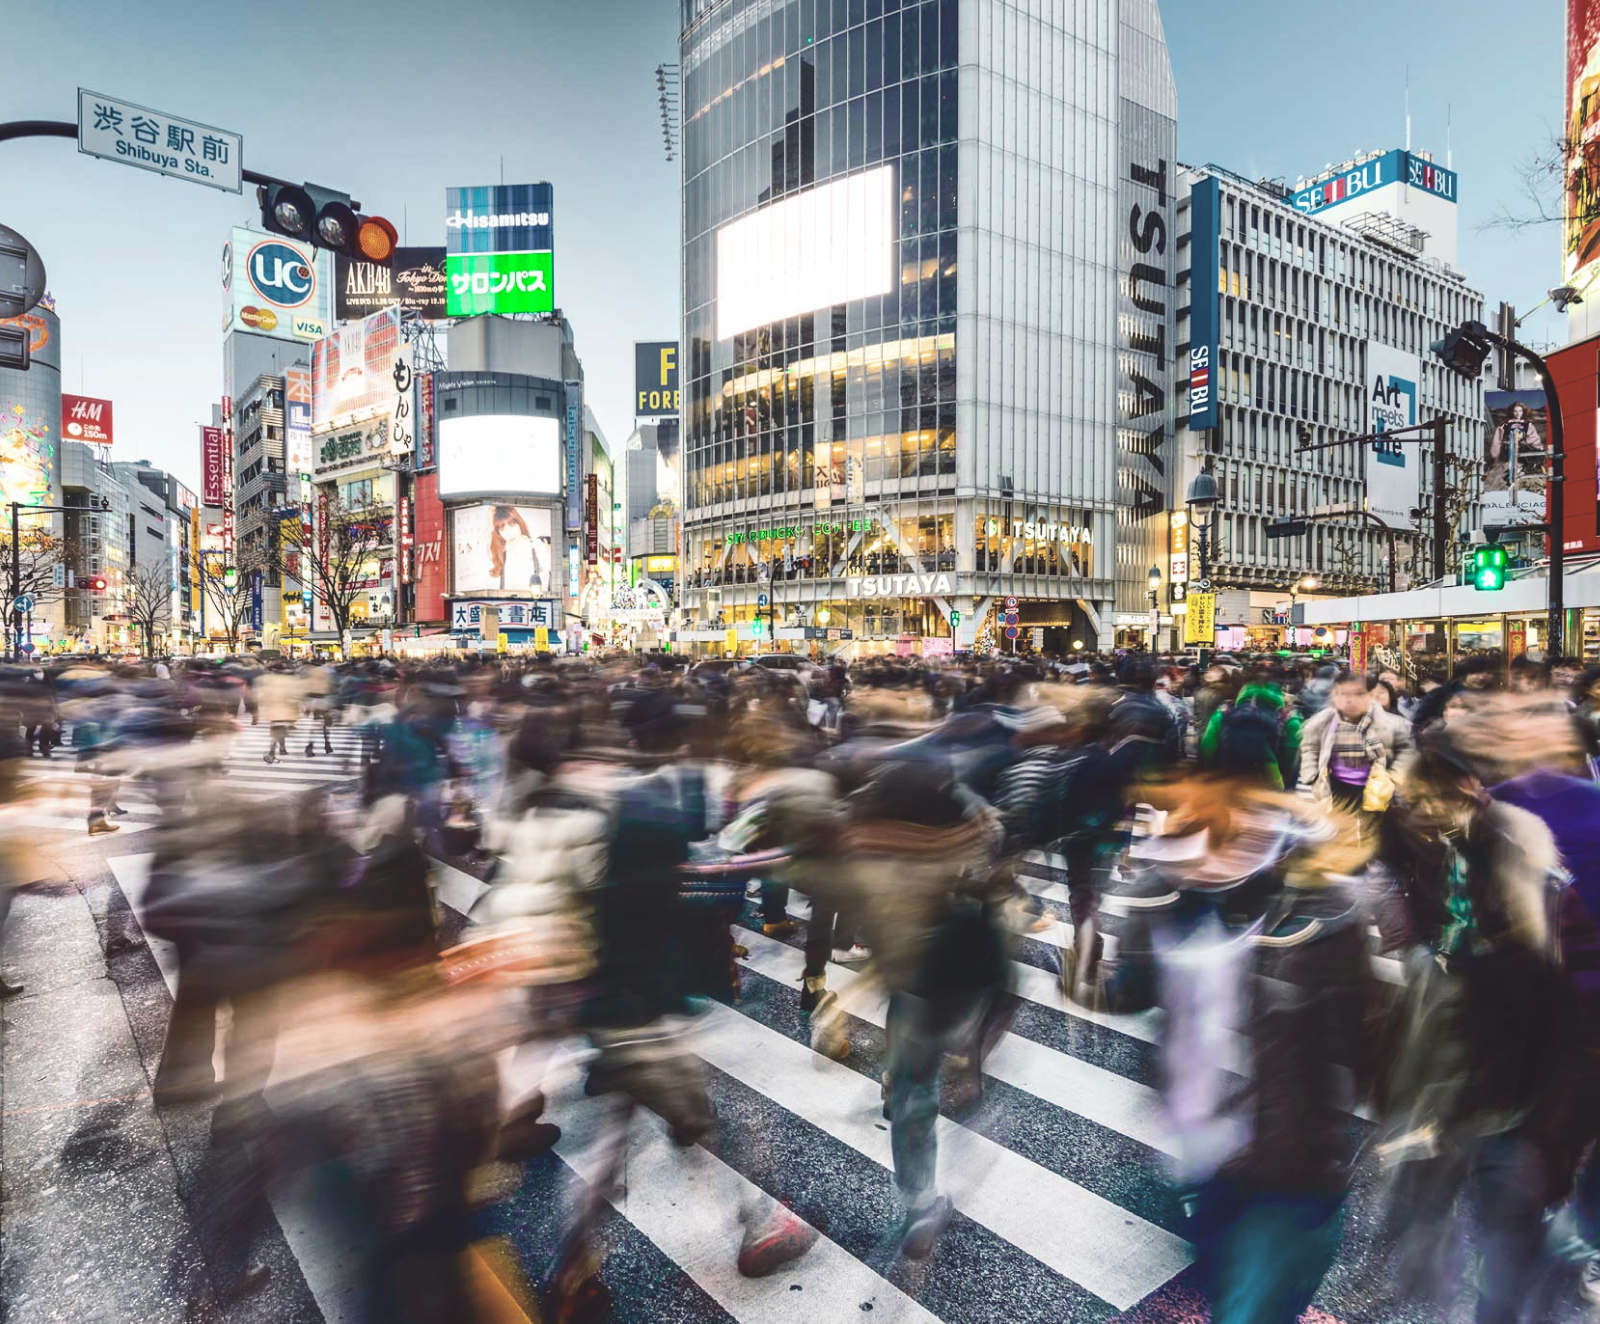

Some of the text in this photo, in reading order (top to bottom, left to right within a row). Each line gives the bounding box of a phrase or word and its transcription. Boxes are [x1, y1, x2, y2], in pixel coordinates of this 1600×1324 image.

[93, 103, 229, 164] 渋谷駅前
[115, 140, 215, 179] Shibuya Sta.
[1296, 161, 1384, 214] SEIBU
[1410, 158, 1452, 199] SEIBU
[446, 209, 549, 229] Hisamitsu
[345, 262, 391, 294] AKB48
[396, 271, 427, 286] Tokyo
[451, 270, 547, 295] サロンパス
[296, 322, 323, 335] VISA
[1129, 159, 1167, 524] TSUTAYA
[661, 348, 676, 386] F
[1191, 345, 1209, 416] SEIBU
[393, 357, 412, 449] もんじゃ
[1372, 374, 1400, 409] Art
[71, 400, 103, 422] H&M
[1372, 405, 1404, 428] meets
[83, 430, 107, 439] 150m
[1372, 423, 1403, 458] Life
[205, 427, 219, 501] Essential
[727, 525, 805, 545] STARBUCKS
[1013, 520, 1091, 545] TSUTAYA
[849, 574, 952, 597] TSUTAYA
[456, 605, 548, 624] 大盛書店
